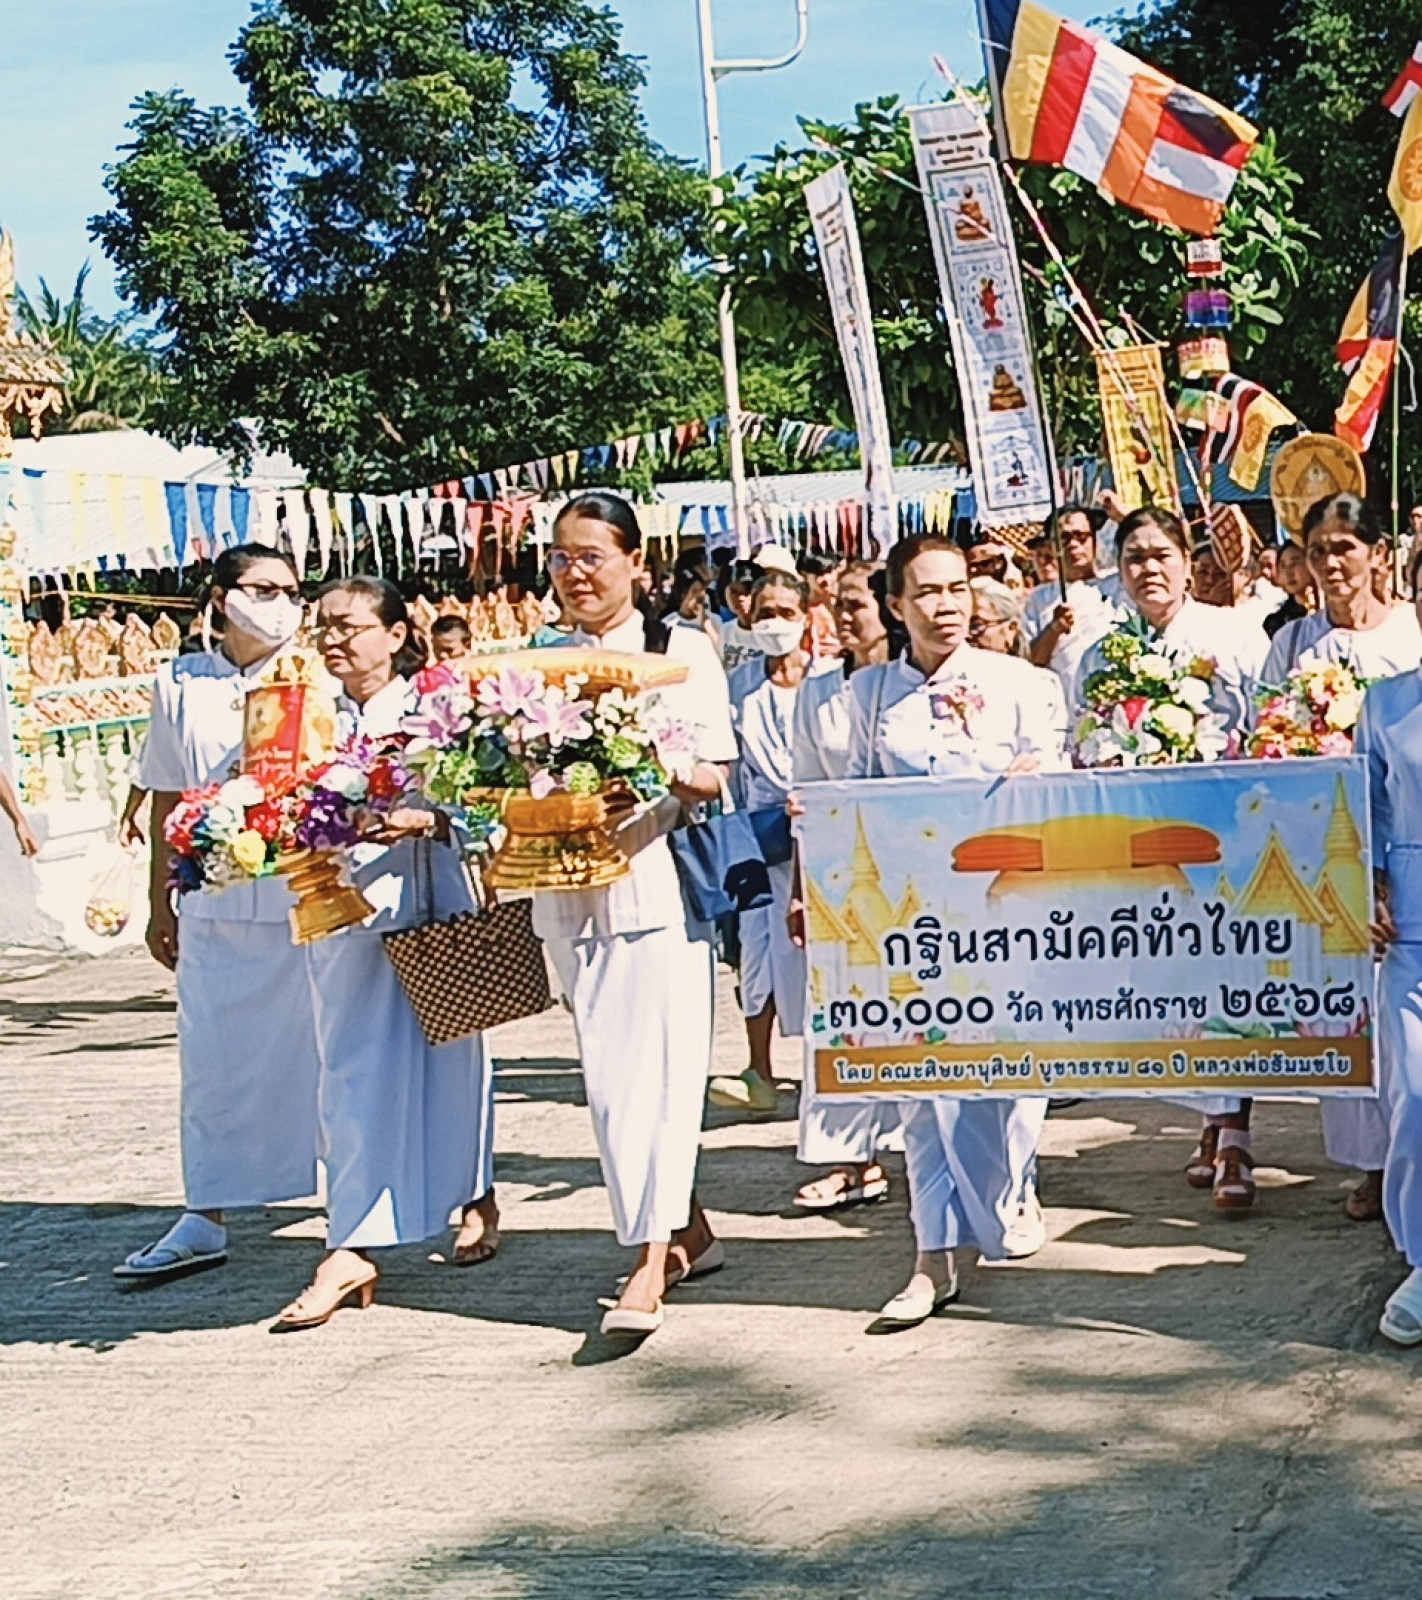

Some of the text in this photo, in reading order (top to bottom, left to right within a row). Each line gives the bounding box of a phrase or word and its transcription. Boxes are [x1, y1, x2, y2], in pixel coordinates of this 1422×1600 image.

[883, 891, 1293, 980] กฐินสามัคคีทั่วไทย
[830, 981, 1355, 1033] ๓๐,๐๐๐ วัด พุทธศักราช ๒๕๖๘
[837, 1050, 1350, 1084] โดย คณะศิษยานุศิษย์ บูชาธรรม ๘๑ ปี หลวงพ่อธัมมชโย
